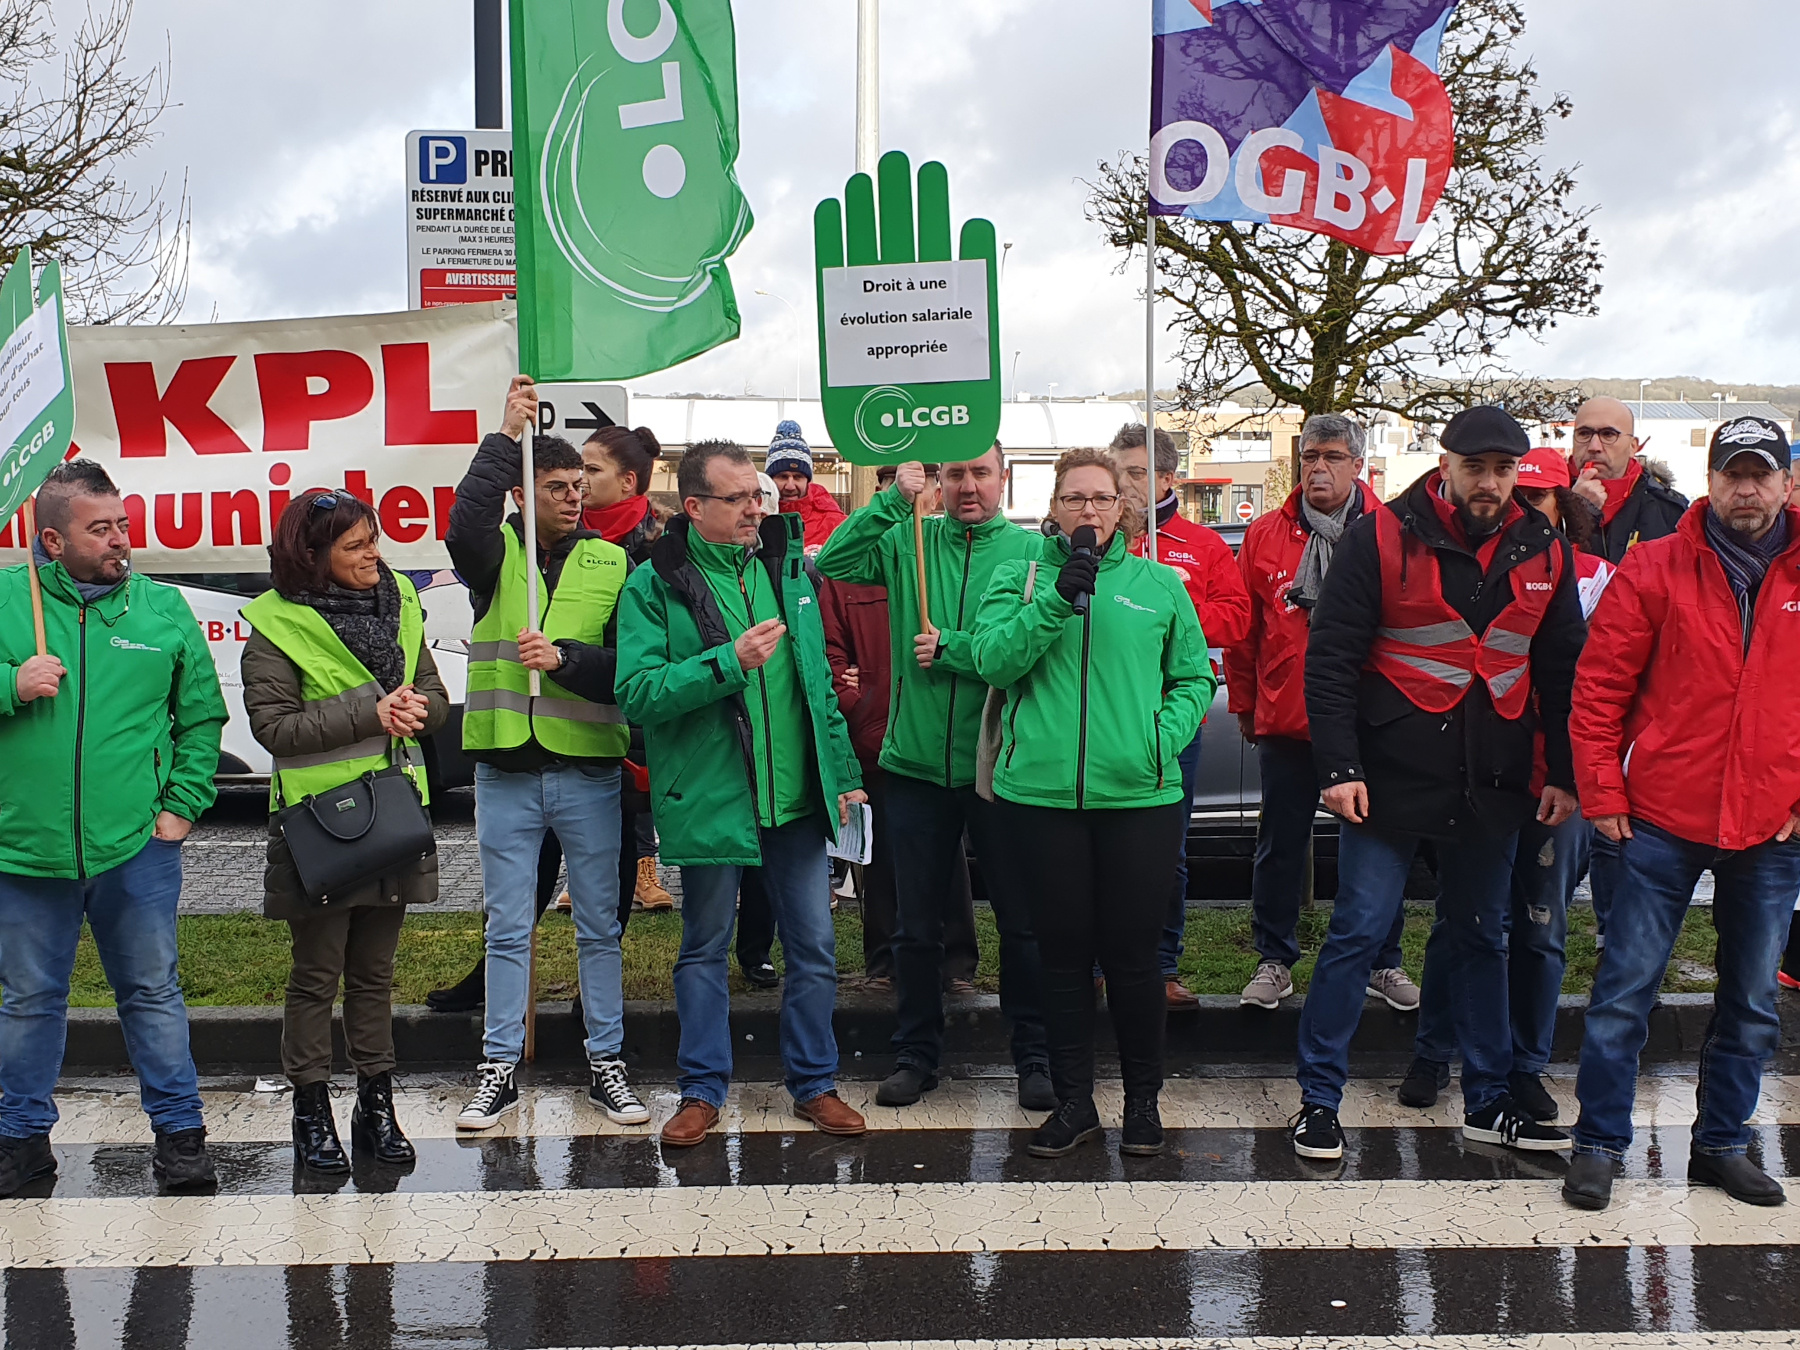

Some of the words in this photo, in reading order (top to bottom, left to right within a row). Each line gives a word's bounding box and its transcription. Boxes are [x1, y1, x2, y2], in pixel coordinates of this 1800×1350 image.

[429, 140, 457, 181] P
[411, 188, 463, 203] RÉSERVÉ
[466, 190, 490, 203] AUX
[416, 207, 505, 222] SUPERMARCHÉ
[416, 225, 451, 233] PENDANT
[453, 225, 462, 233] LA
[464, 225, 489, 234] DURÉE
[491, 226, 500, 234] DE
[478, 236, 483, 244] 3
[433, 248, 466, 256] PARKING
[467, 248, 503, 256] FERMERA
[447, 258, 492, 266] FERMETURE
[493, 258, 504, 266] DU
[863, 279, 902, 293] Droit
[906, 278, 915, 291] à
[919, 279, 947, 290] une
[840, 311, 907, 326] évolution
[912, 307, 973, 322] salariale
[867, 340, 948, 359] appropriée
[12, 377, 31, 402] tous
[104, 341, 478, 459] KPL
[897, 405, 970, 428] LCGB
